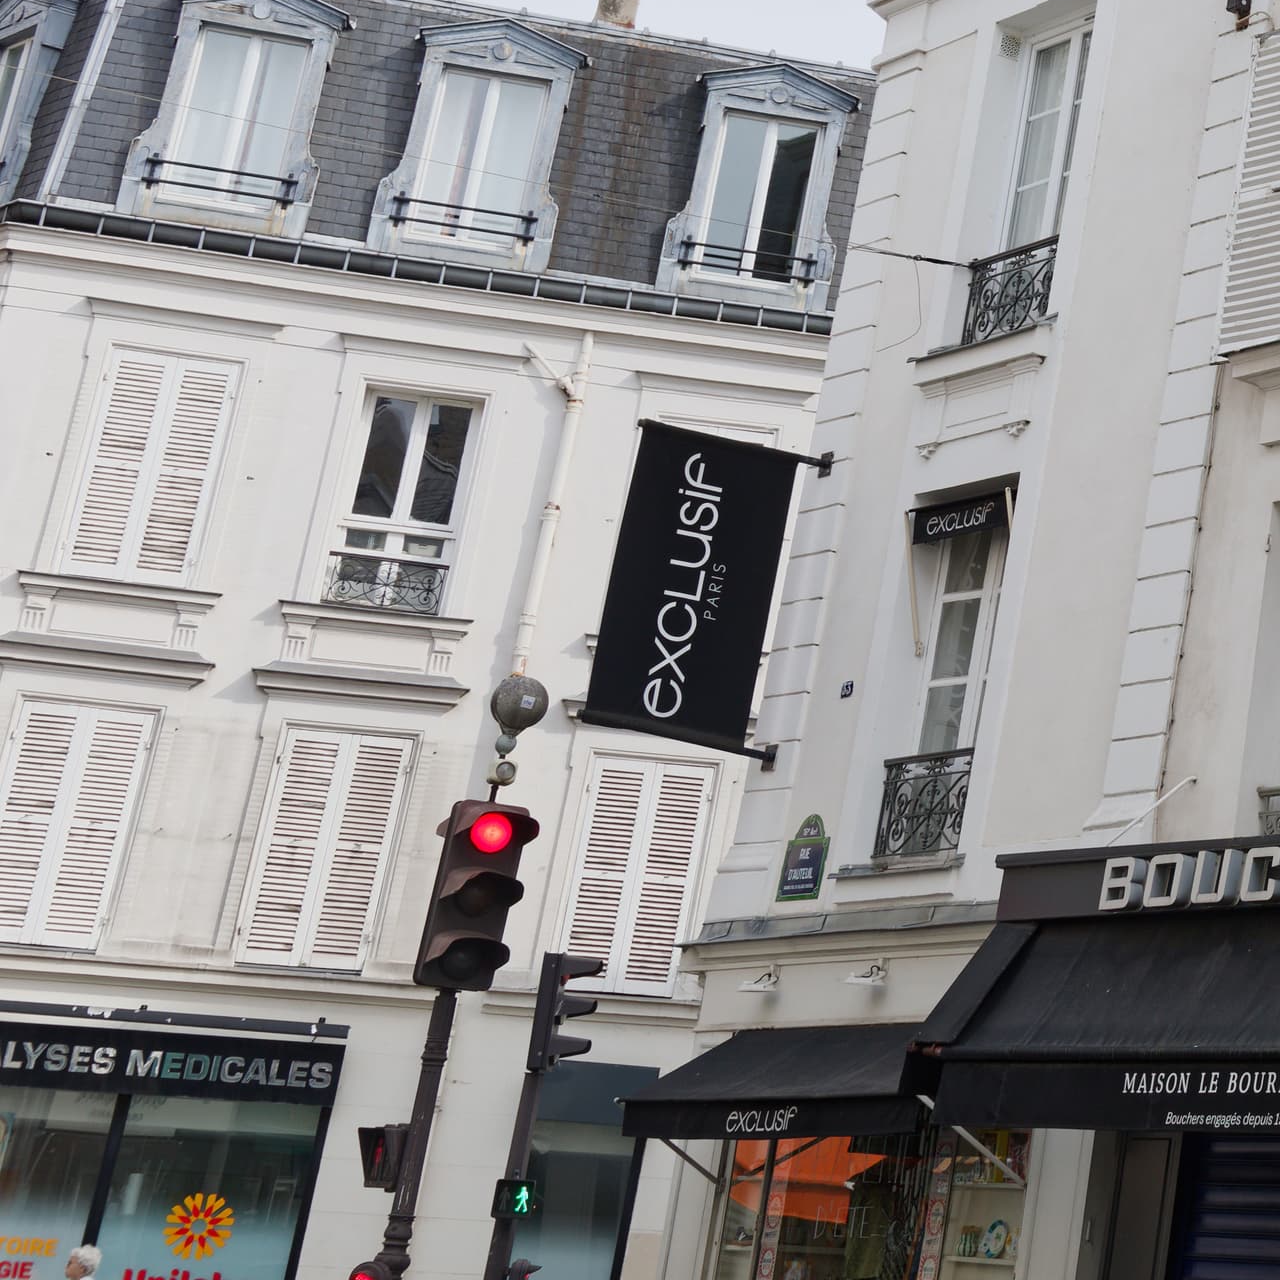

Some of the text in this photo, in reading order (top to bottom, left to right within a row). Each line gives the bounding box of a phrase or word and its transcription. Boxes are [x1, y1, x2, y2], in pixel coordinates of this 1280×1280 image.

[703, 563, 727, 620] PARIS
[2, 1040, 334, 1089] LYSES MEDICALES
[1122, 1072, 1191, 1094] MAISON
[1198, 1072, 1219, 1094] LE
[1165, 1111, 1204, 1126] Bouchers
[1205, 1112, 1241, 1128] engagés
[1243, 1112, 1273, 1128] depuis
